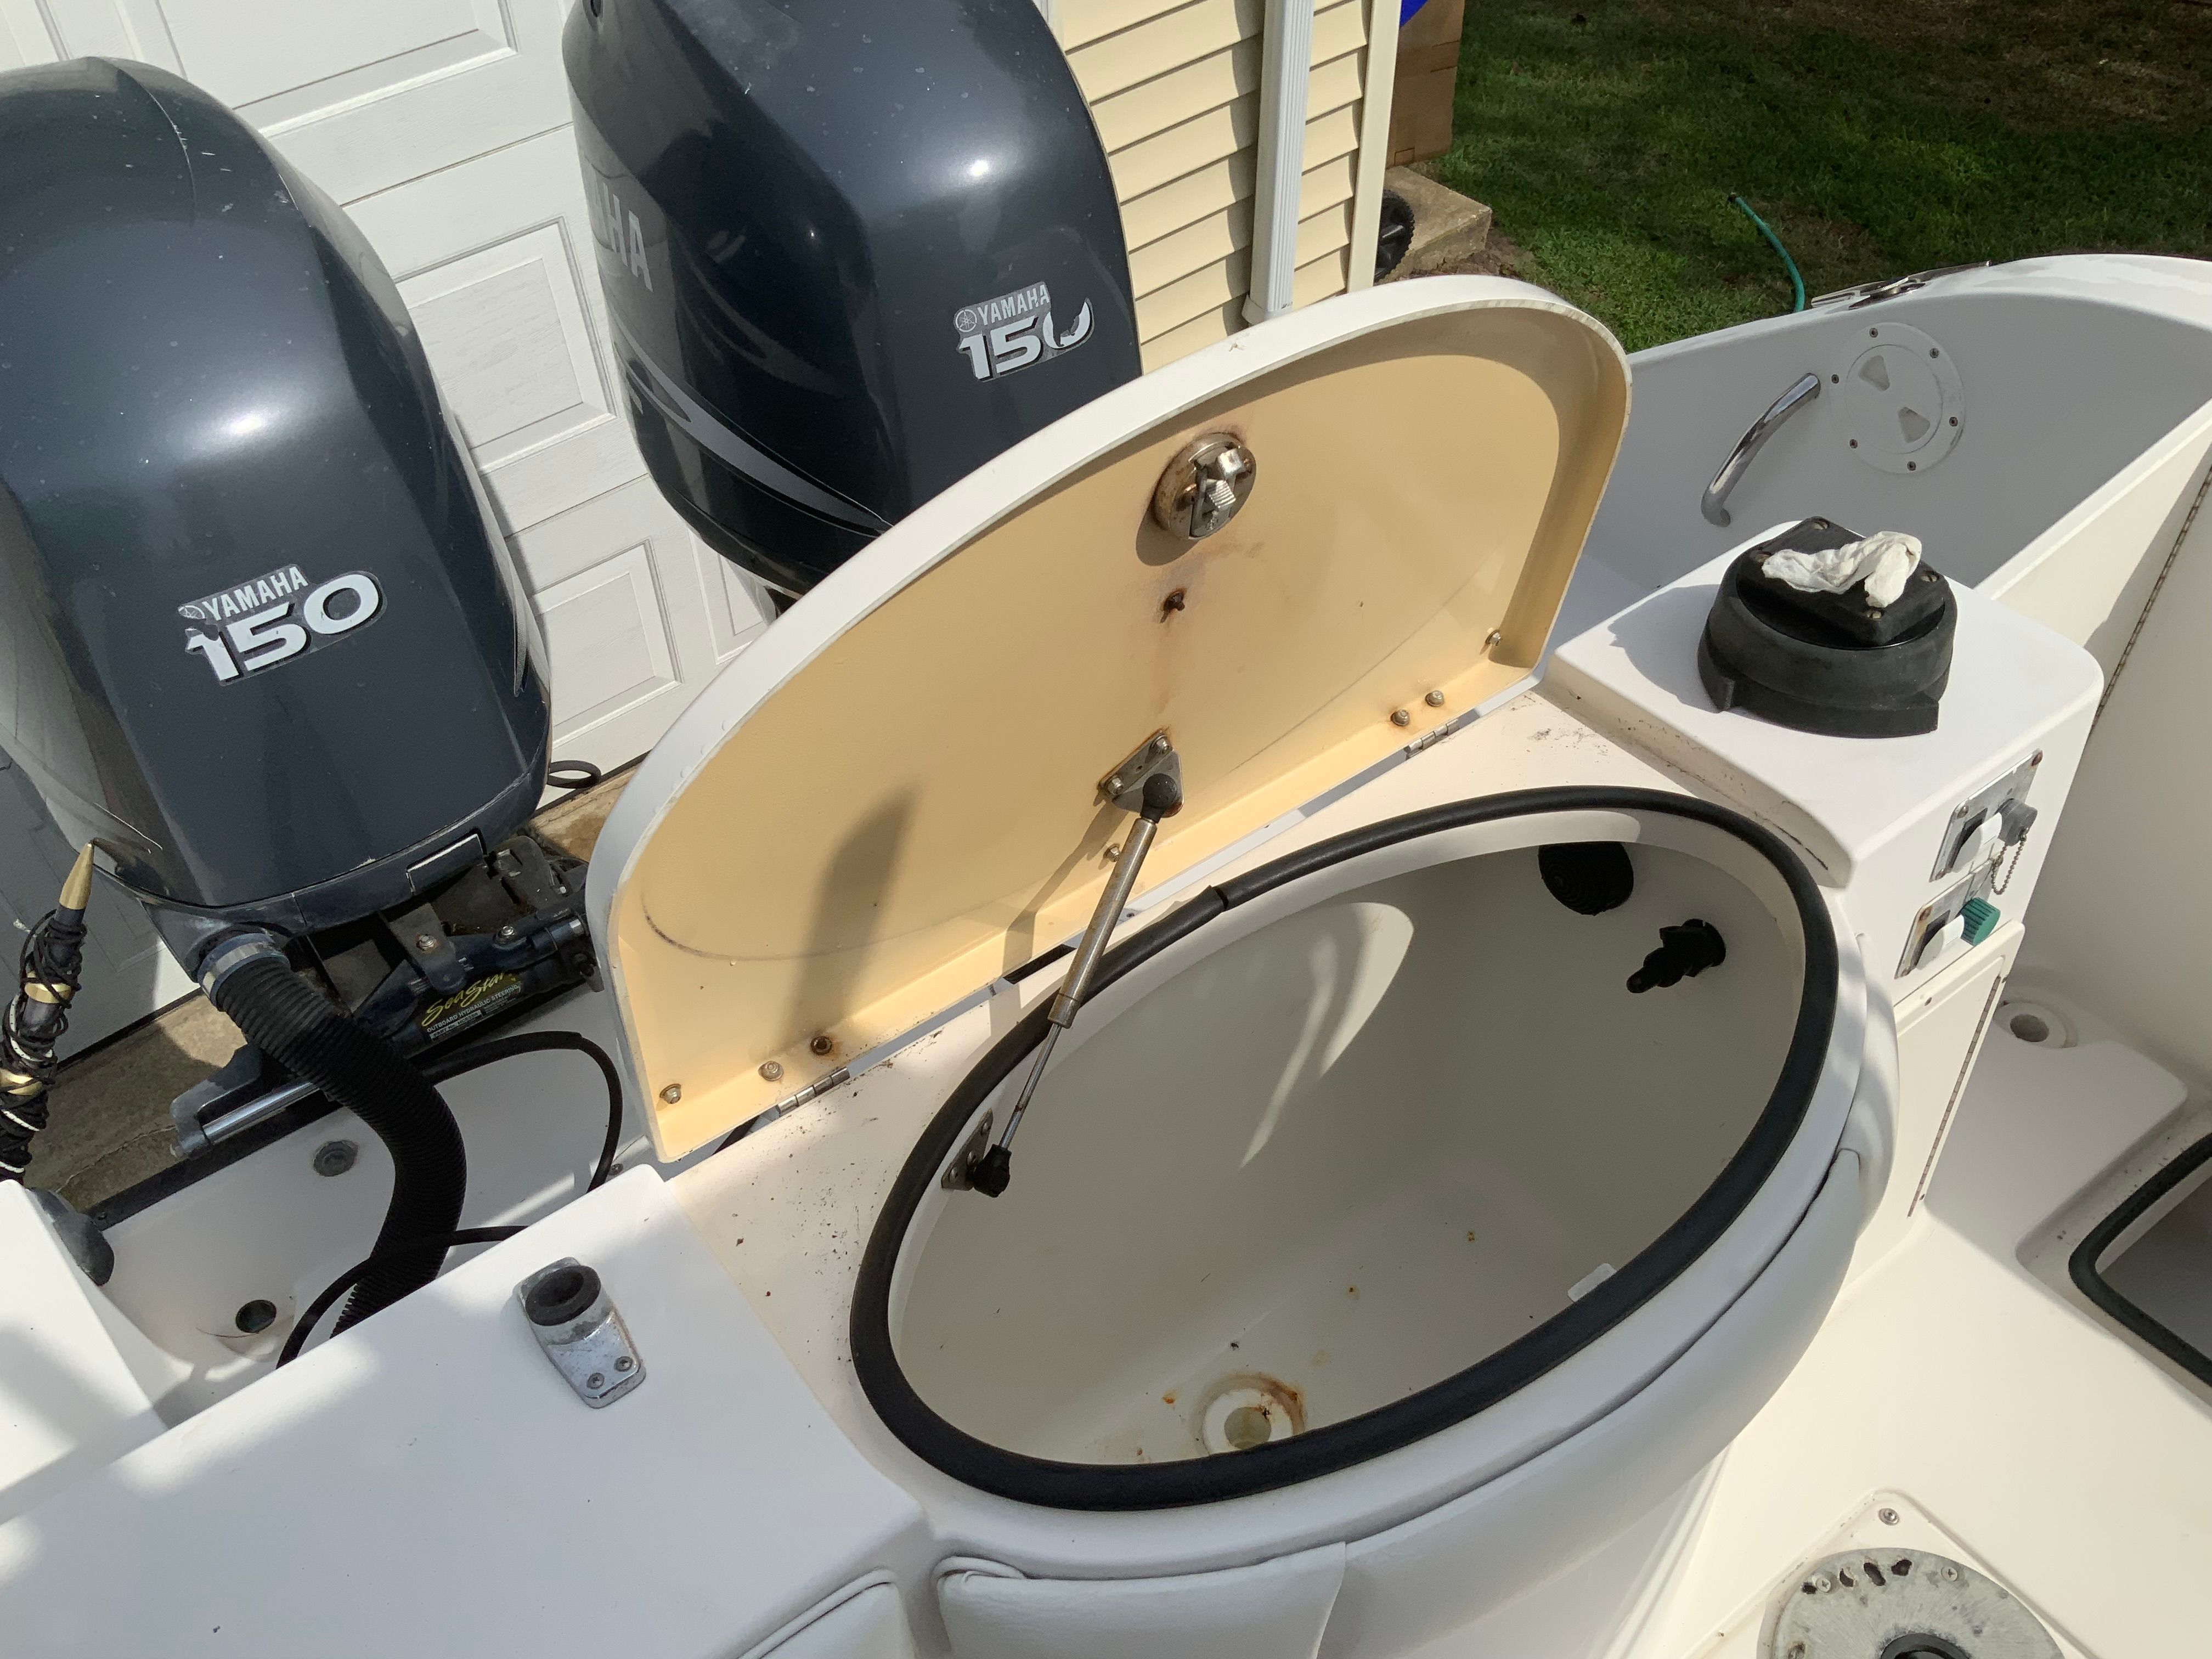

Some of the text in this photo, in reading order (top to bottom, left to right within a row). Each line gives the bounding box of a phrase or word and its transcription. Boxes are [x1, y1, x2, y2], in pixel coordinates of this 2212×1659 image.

[977, 284, 1050, 325] YAMAHA
[202, 566, 309, 621] YAMAHA
[187, 573, 382, 681] 150
[426, 1014, 459, 1033] OUTBOARD
[459, 998, 491, 1018] HYDRAULIC
[490, 984, 520, 1002] STEERING
